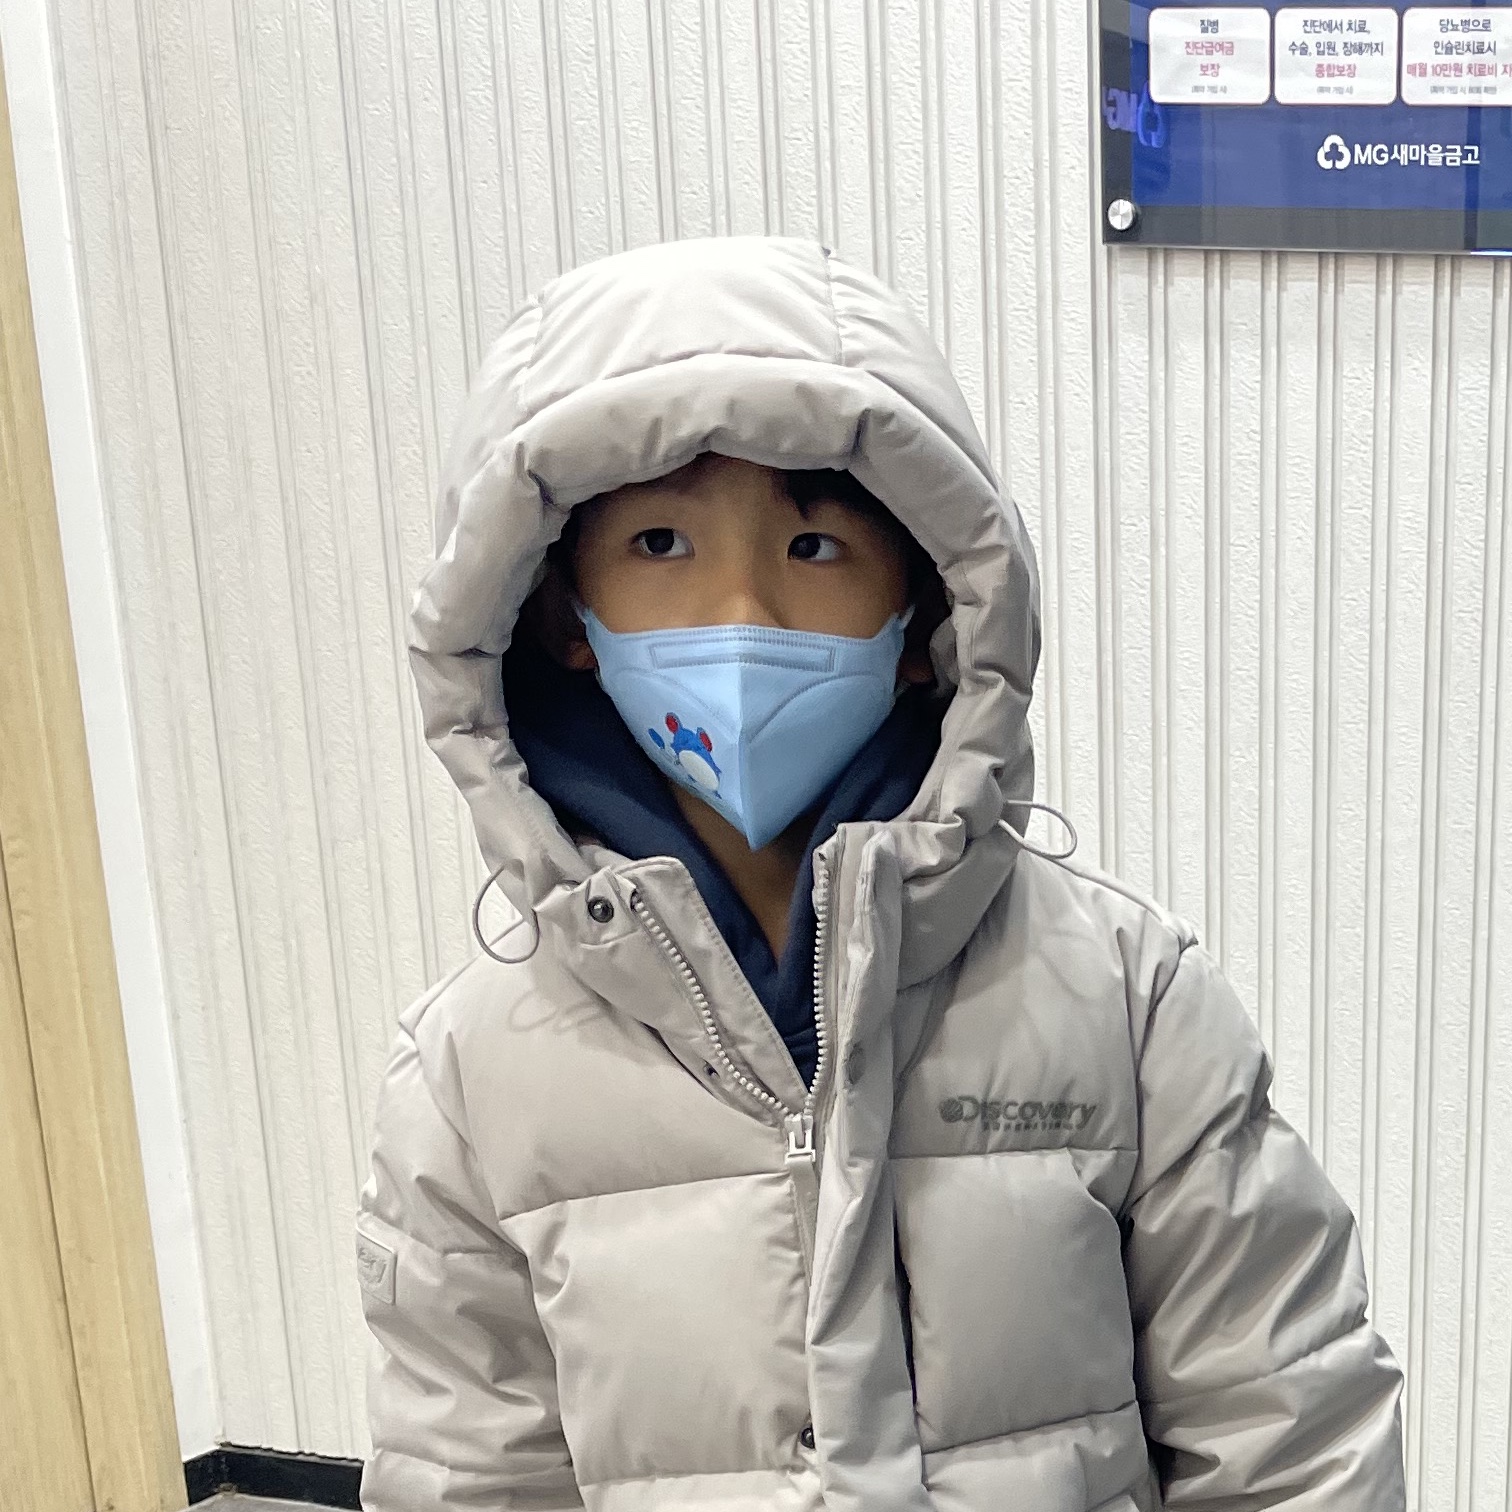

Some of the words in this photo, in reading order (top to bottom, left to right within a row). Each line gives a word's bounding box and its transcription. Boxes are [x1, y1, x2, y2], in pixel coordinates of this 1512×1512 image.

[1199, 18, 1219, 34] 질병
[1302, 18, 1343, 34] 진단에서
[1346, 19, 1371, 34] 치료,
[1439, 18, 1492, 33] 당뇨병으로
[1184, 41, 1235, 56] 진단급여금
[1288, 41, 1312, 57] 수술,
[1315, 41, 1339, 57] 입원,
[1342, 41, 1384, 57] 장해까지
[1433, 40, 1497, 56] 인슐린치료시
[1199, 63, 1221, 77] 보장
[1315, 63, 1356, 78] 종합보장
[1406, 62, 1428, 78] 매월
[1431, 62, 1463, 78] 10만원
[1466, 62, 1498, 78] 치료비
